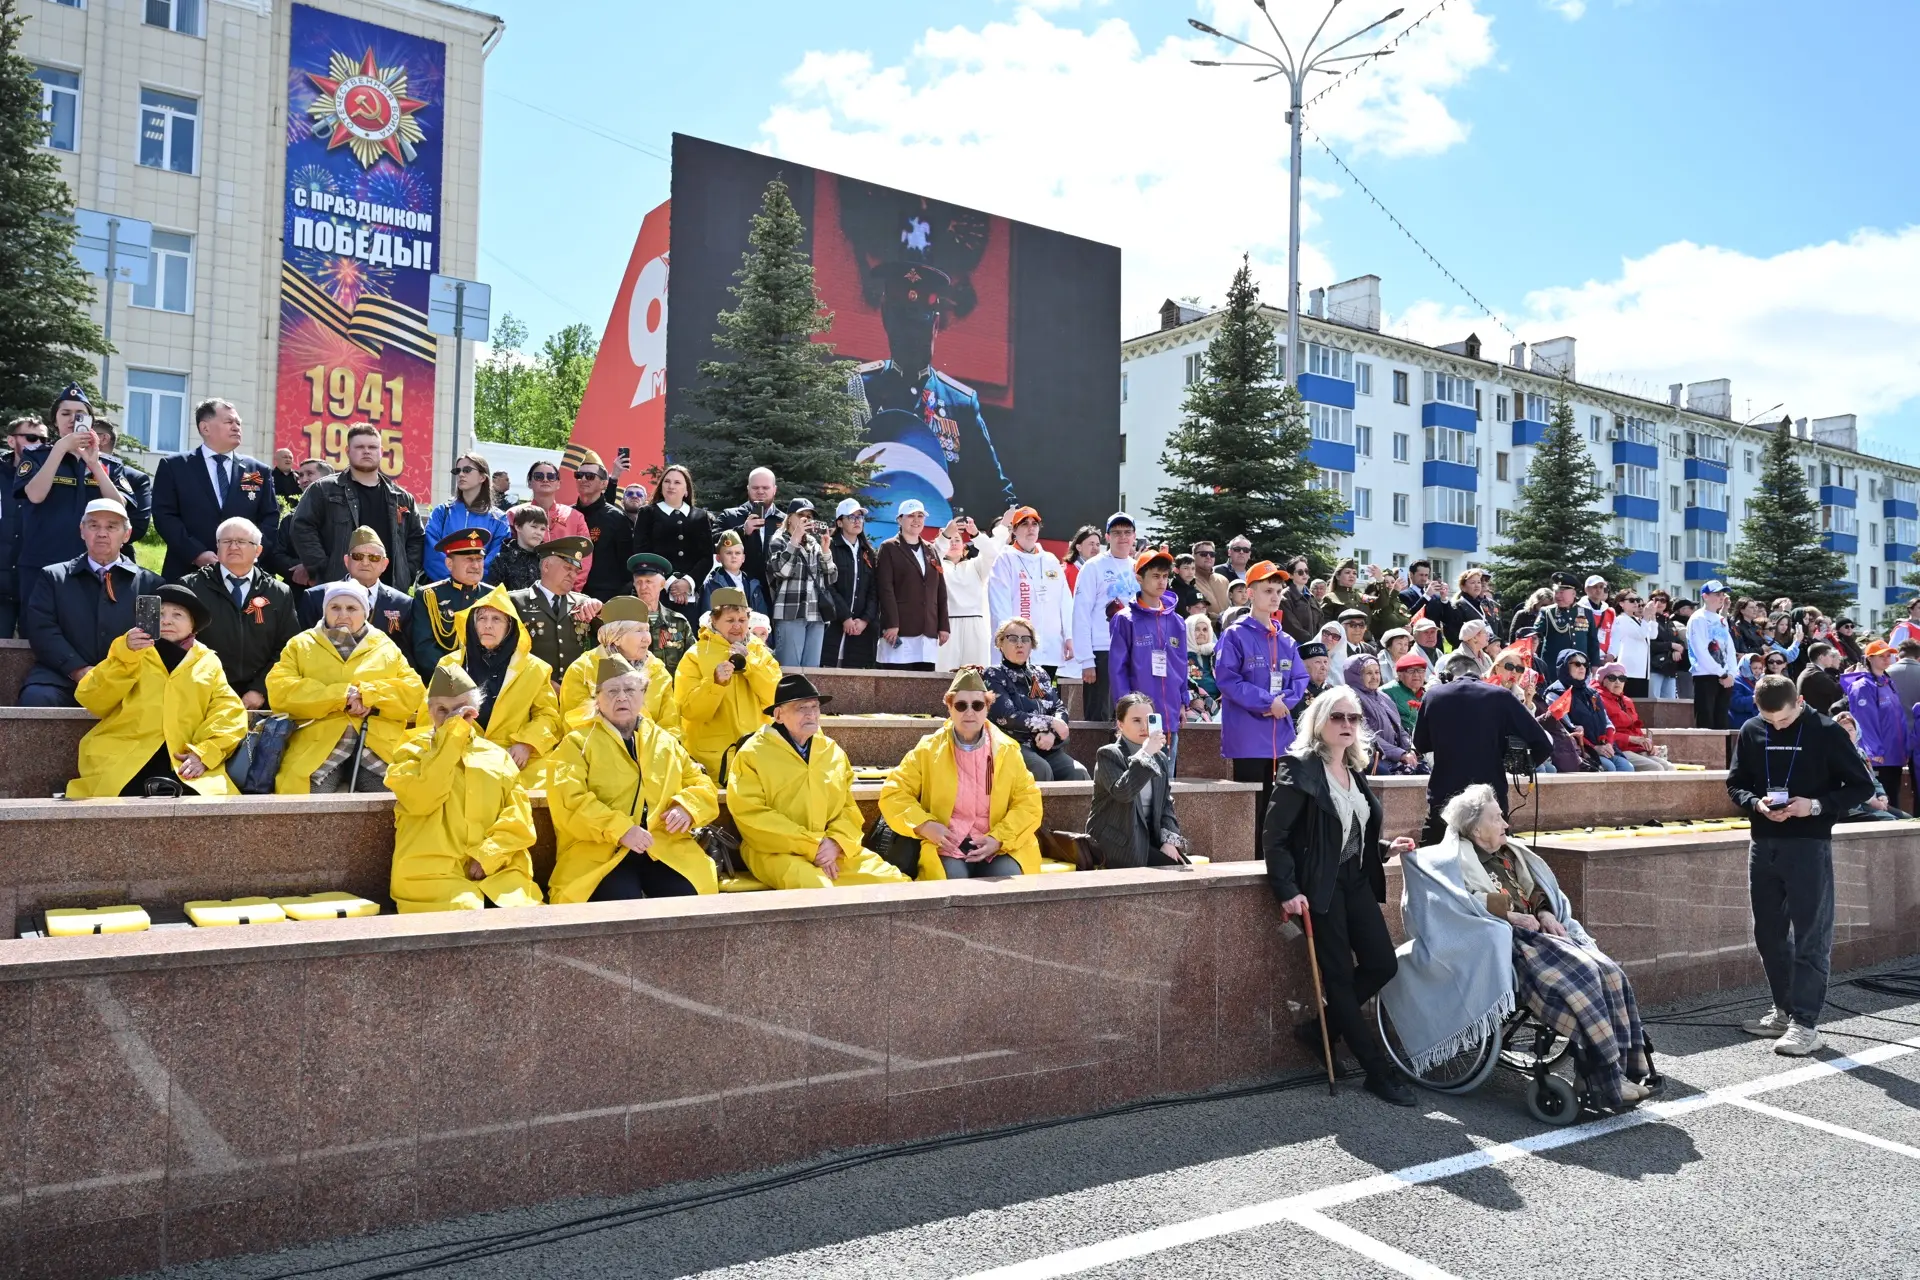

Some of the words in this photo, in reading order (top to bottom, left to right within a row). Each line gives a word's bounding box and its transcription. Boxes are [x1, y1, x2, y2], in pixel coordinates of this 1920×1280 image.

[336, 77, 394, 129] ОТЕЧЕСТВЕННАЯ
[379, 105, 399, 137] ВОЙНА
[294, 187, 307, 207] С
[311, 191, 433, 233] ПРАЗДНИКОМ
[293, 216, 433, 271] ПОБЕДЫ!
[305, 364, 404, 424] 1941
[303, 420, 404, 477] 195
[1019, 582, 1031, 620] ОЛОНТЕР
